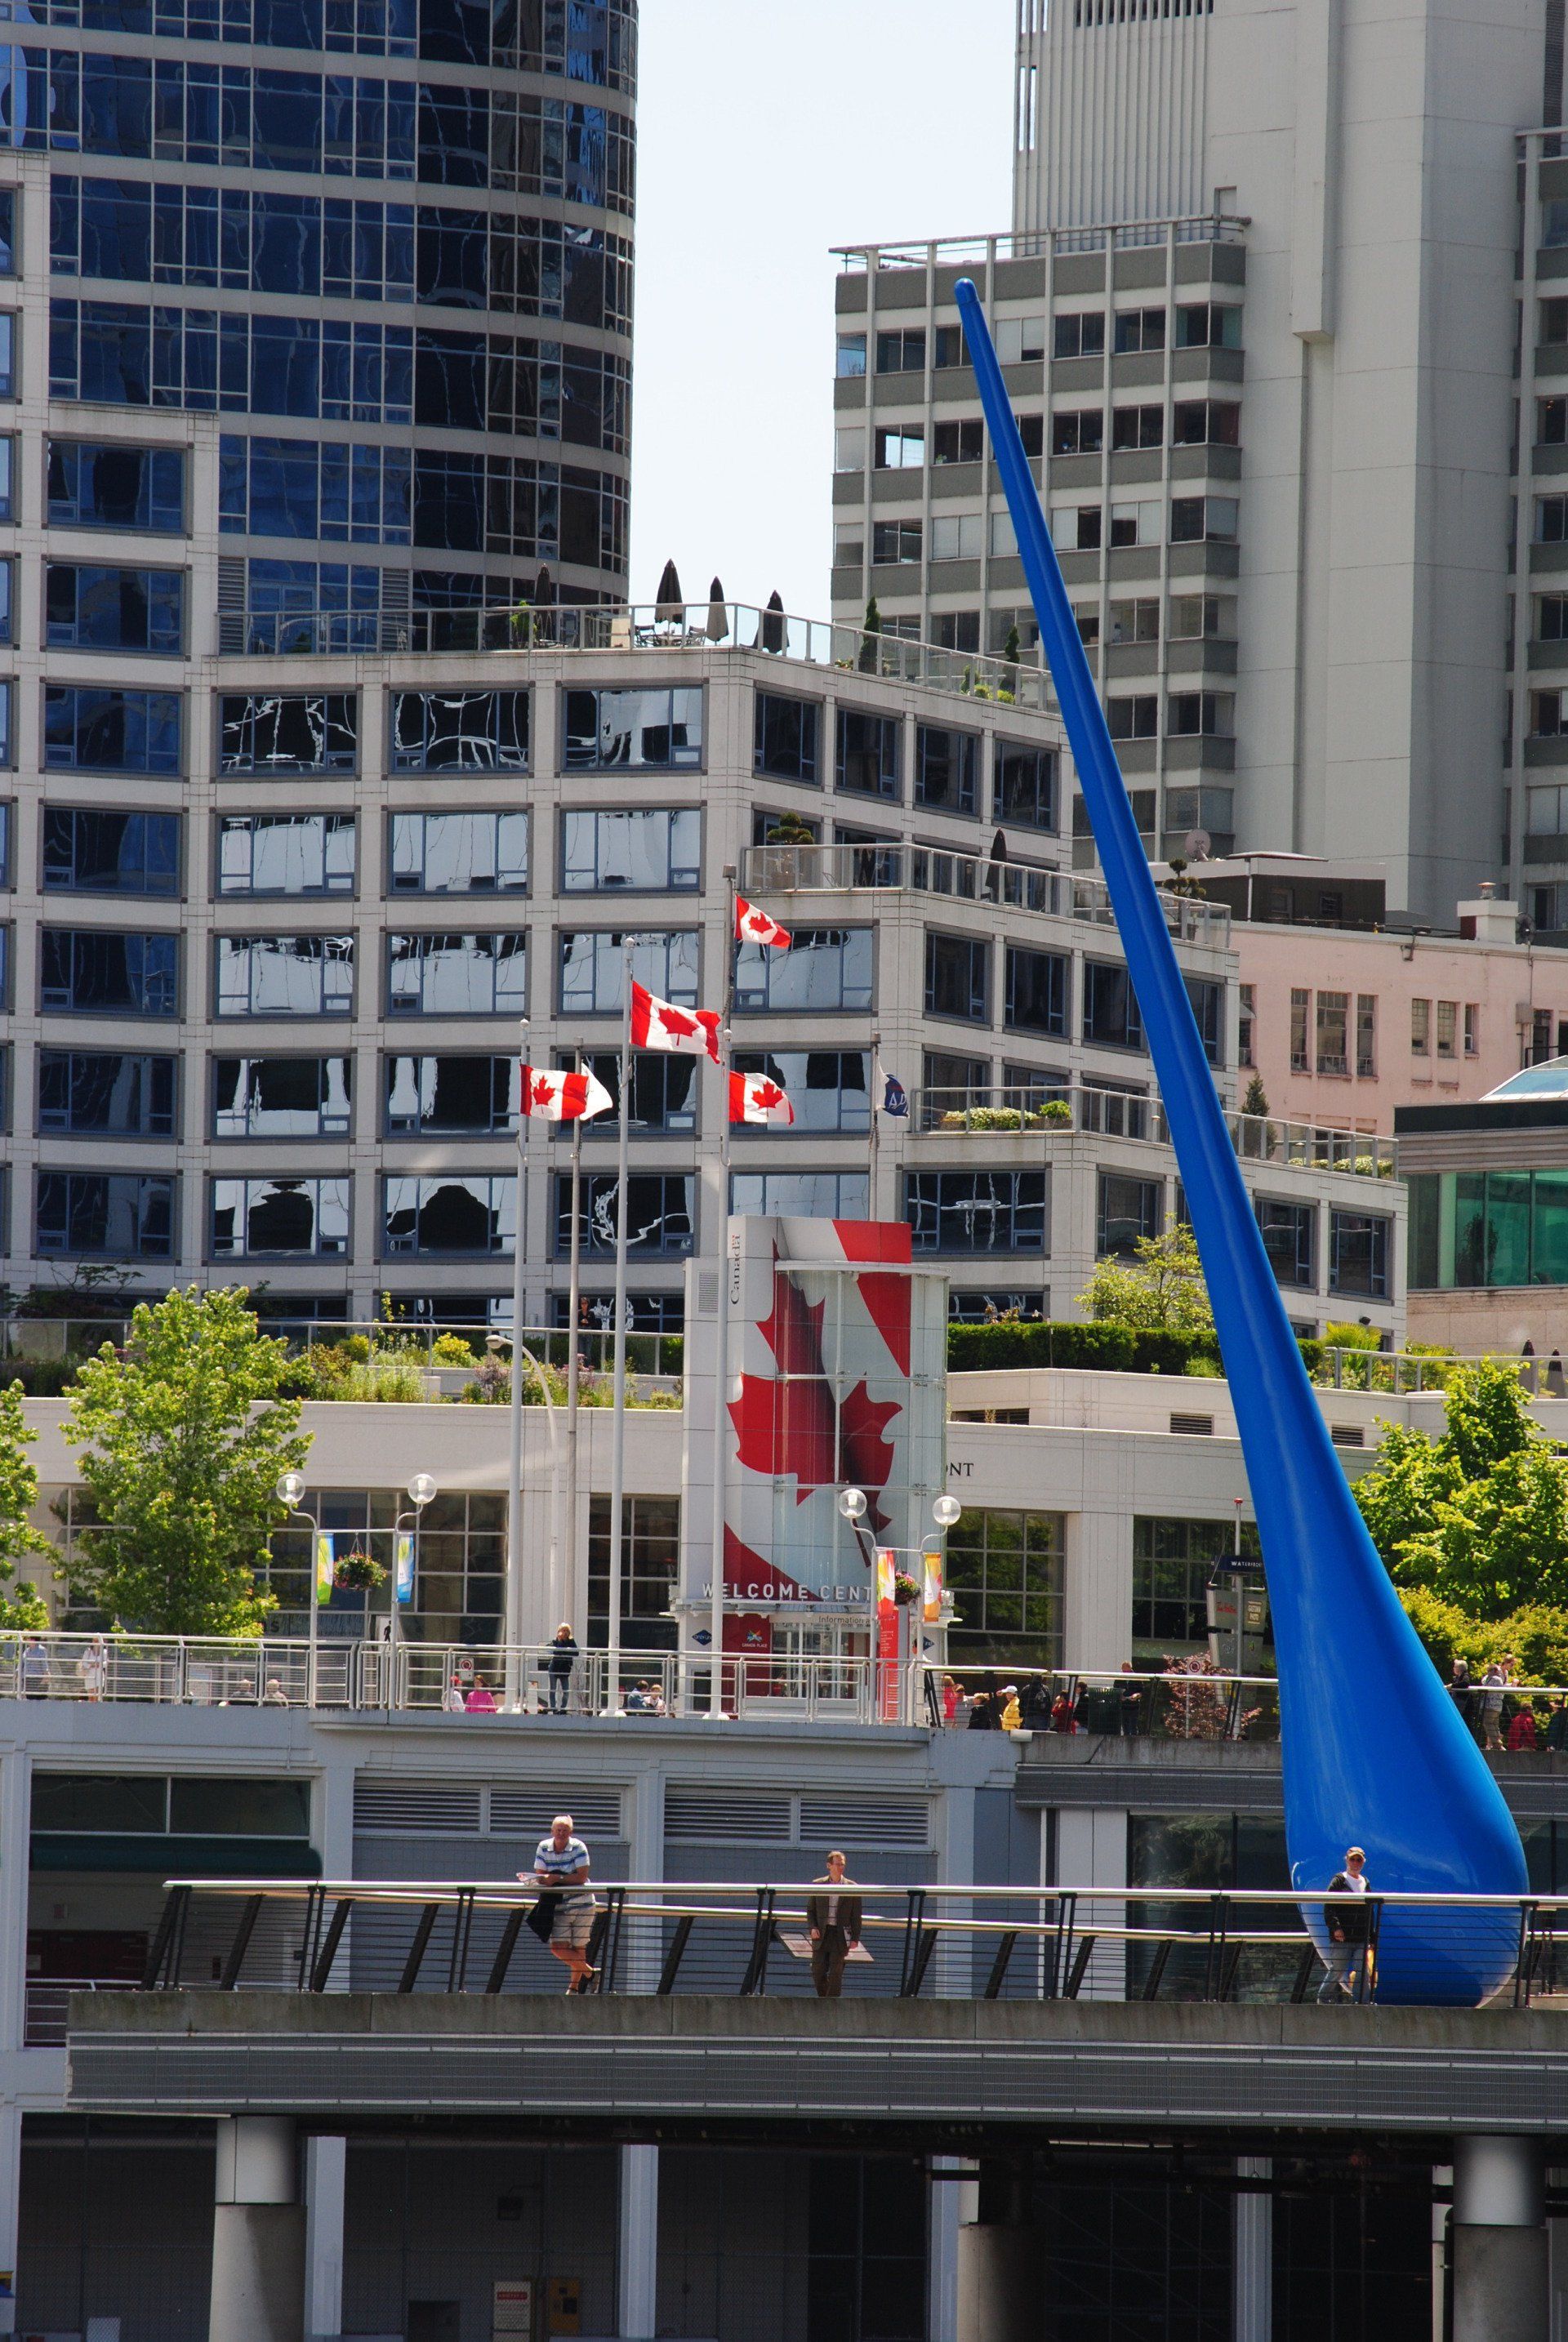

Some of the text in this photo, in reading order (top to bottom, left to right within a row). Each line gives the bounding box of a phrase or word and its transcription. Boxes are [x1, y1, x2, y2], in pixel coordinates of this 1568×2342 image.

[730, 1235, 740, 1304] Canada
[946, 1462, 974, 1476] NT
[702, 1582, 872, 1601] WELCOME CENT
[818, 1615, 864, 1624] Information
